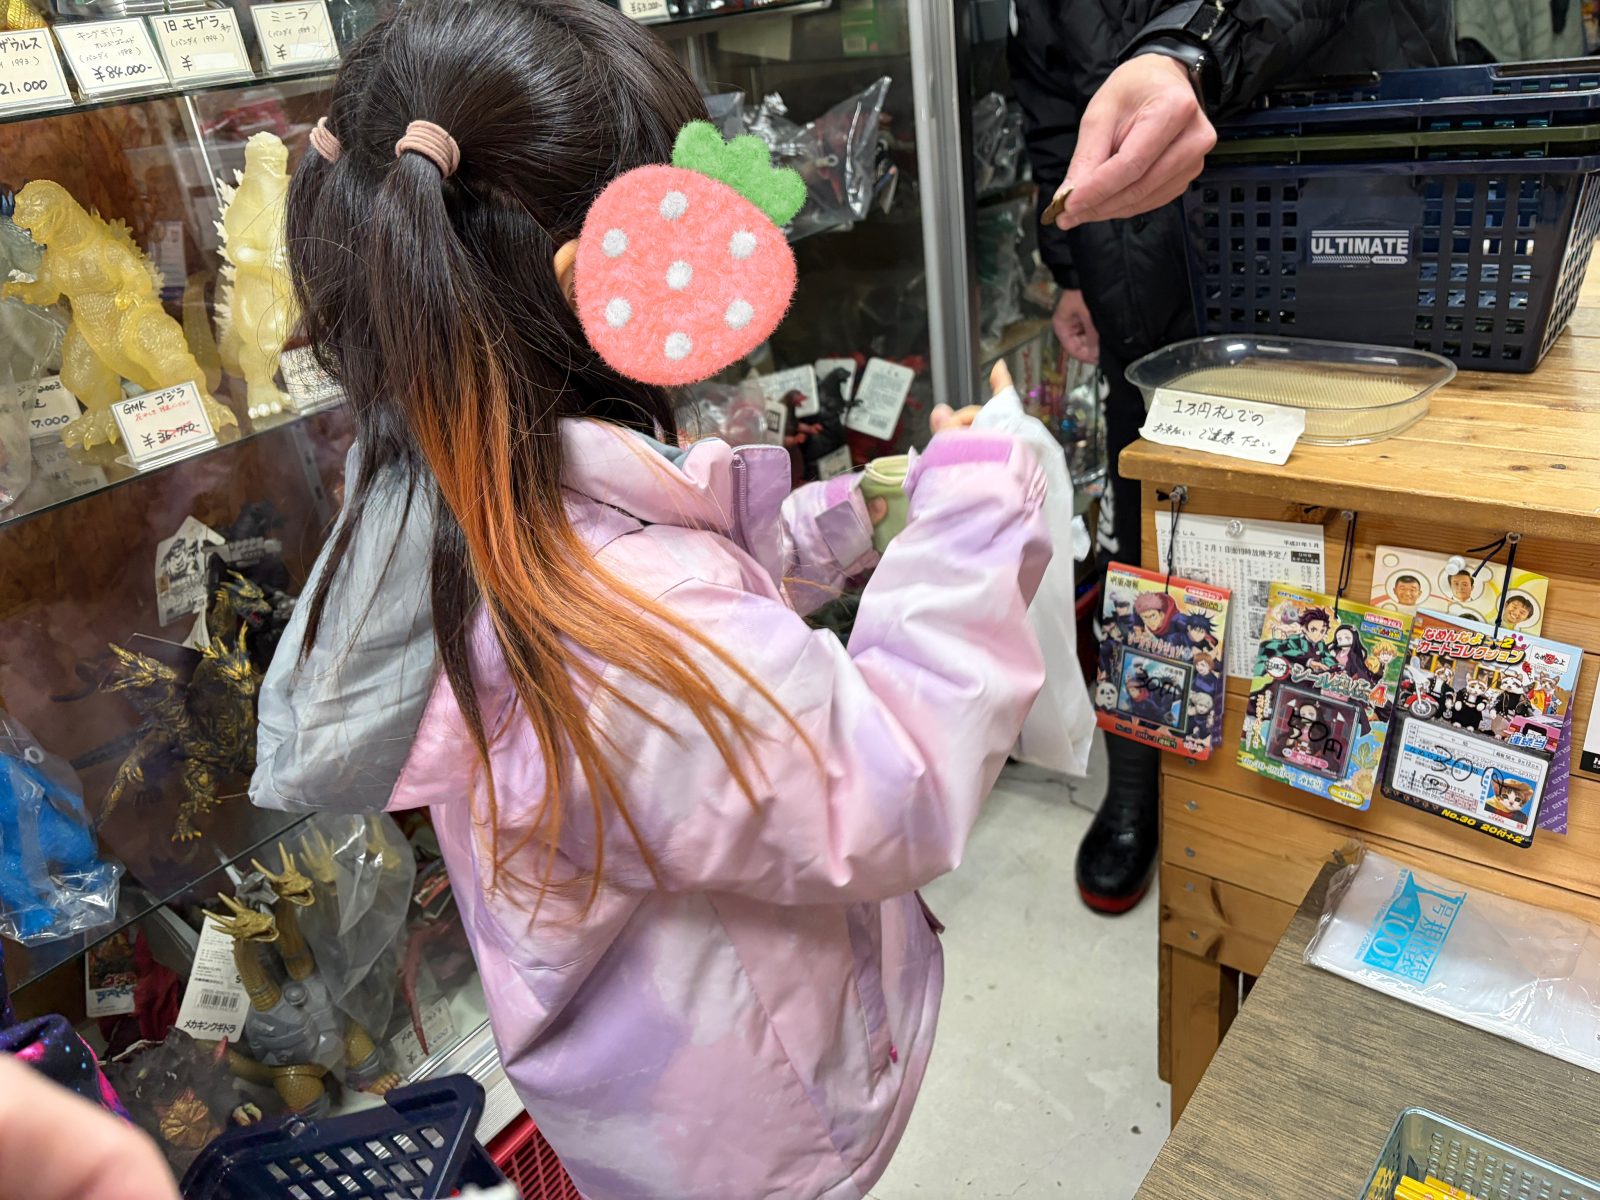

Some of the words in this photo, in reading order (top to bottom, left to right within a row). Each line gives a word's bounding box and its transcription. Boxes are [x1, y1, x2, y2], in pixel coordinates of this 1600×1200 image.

[182, 15, 220, 31] モゲラ
[271, 8, 309, 23] ミニラ
[76, 26, 124, 40] キングギドラ
[274, 43, 288, 61] ¥
[180, 54, 193, 72] ¥
[1311, 237, 1409, 255] ULTIMATE
[123, 400, 147, 416] GMK
[154, 387, 185, 406] ゴジラ
[1423, 628, 1485, 645] なめんなよ
[1501, 637, 1516, 649] 2
[1418, 642, 1527, 664] カードコレクション
[1288, 709, 1344, 760] 50円
[1441, 808, 1477, 827] No.30
[1481, 822, 1525, 845] 20付+2
[184, 1019, 237, 1034] メカキングギドラ
